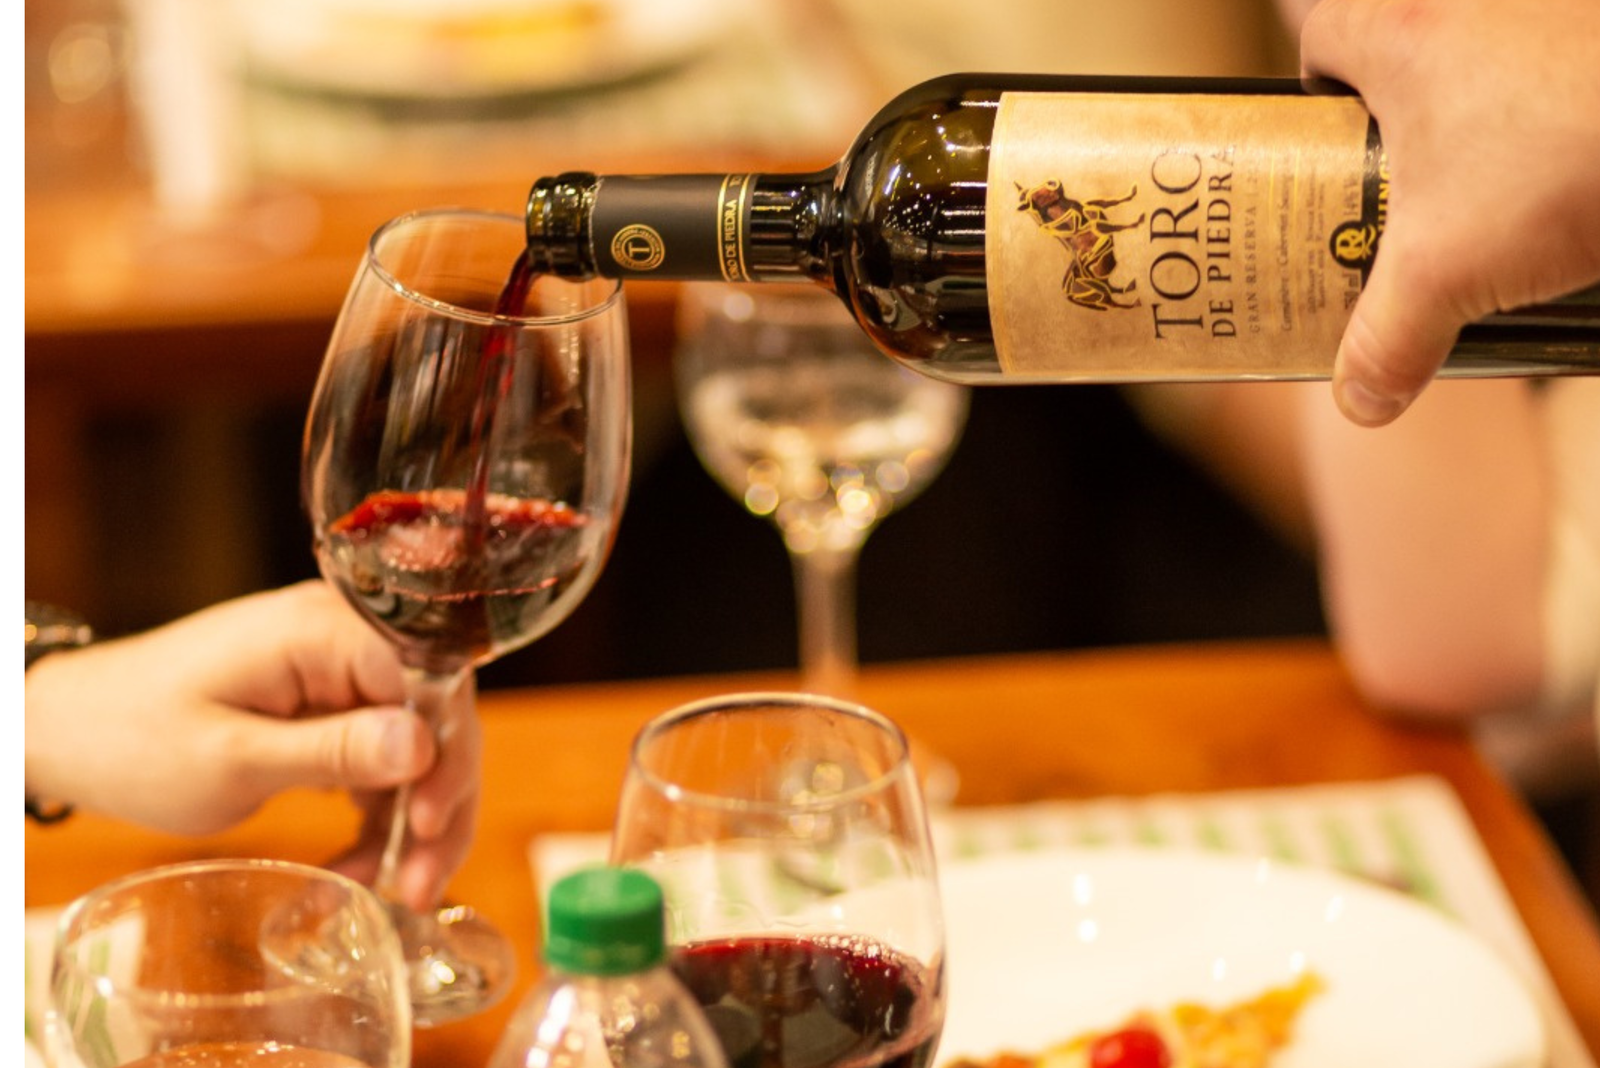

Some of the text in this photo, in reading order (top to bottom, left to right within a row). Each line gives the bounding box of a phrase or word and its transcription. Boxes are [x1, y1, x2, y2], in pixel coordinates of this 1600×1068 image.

[724, 199, 738, 241] PIEDRA
[628, 242, 650, 258] T
[725, 243, 737, 258] DE
[1206, 145, 1237, 338] DE PIEDRA
[1244, 206, 1261, 334] GRAN RESERVA
